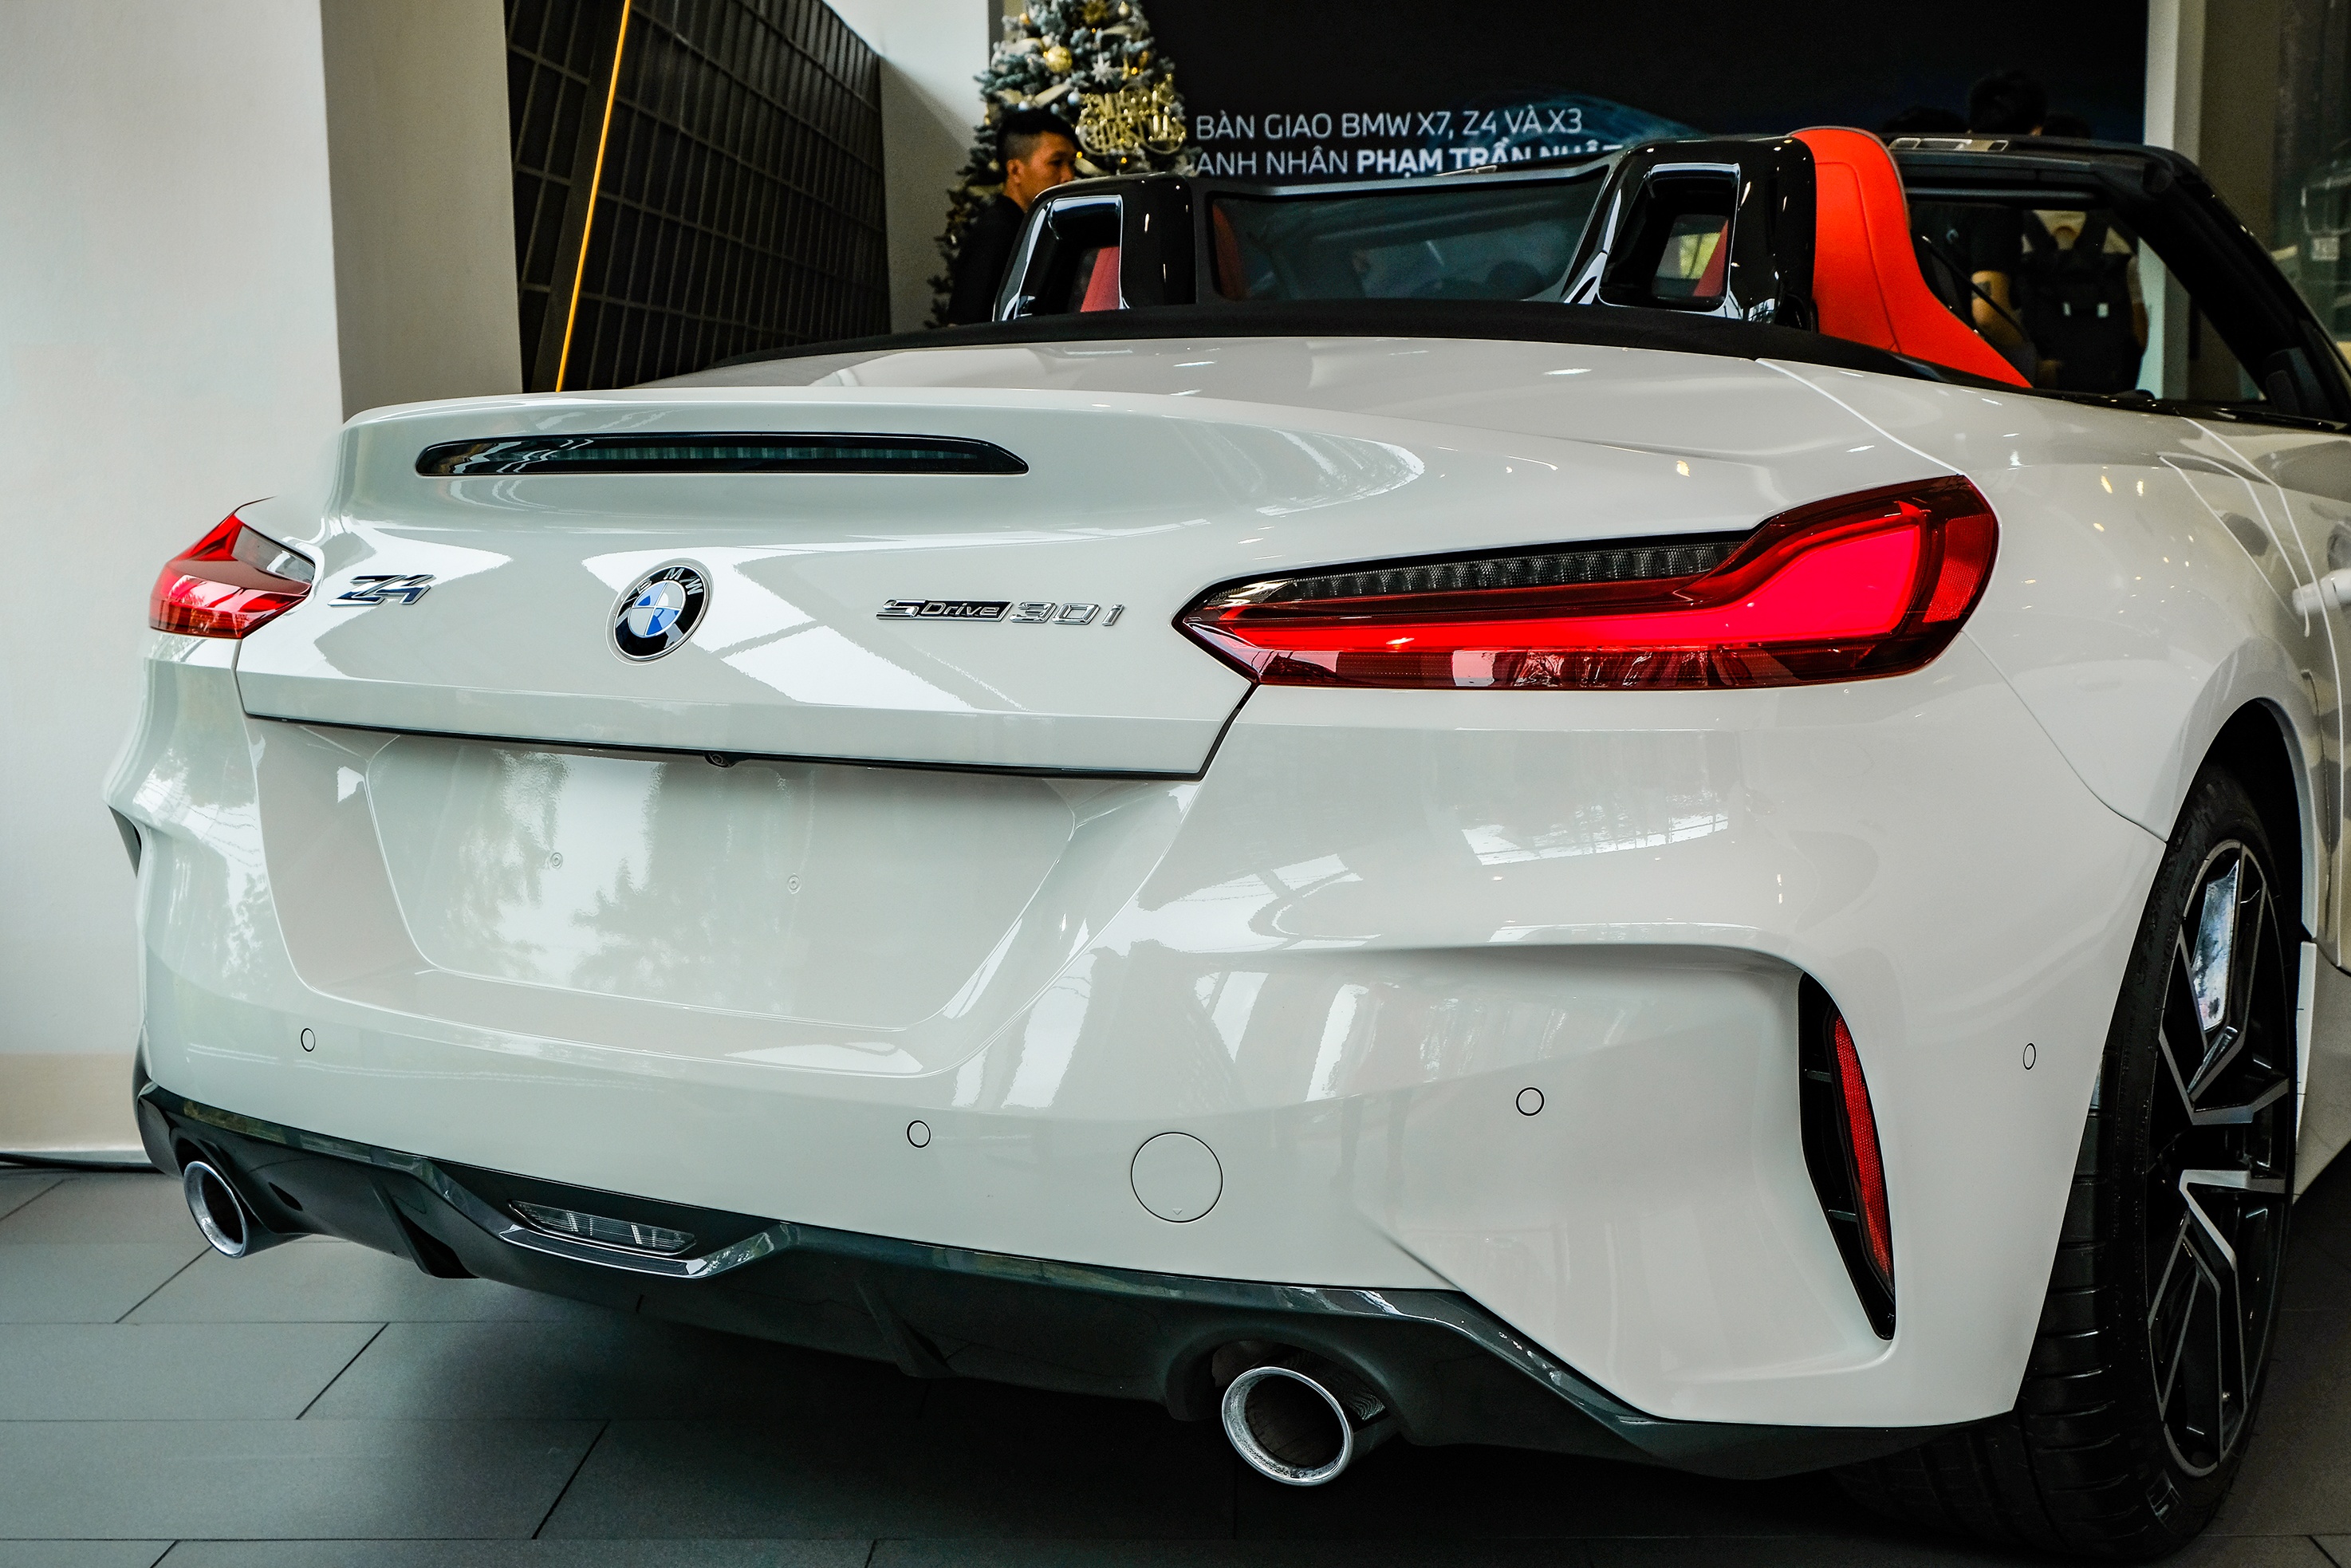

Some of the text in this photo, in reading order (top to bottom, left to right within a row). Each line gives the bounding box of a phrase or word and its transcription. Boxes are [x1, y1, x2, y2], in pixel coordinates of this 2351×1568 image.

[1196, 104, 1582, 140] BÀN GIAO BMW X7, Z4 VÀ X3
[1266, 145, 1348, 175] NHÂN
[1357, 148, 1443, 178] PHẠM
[327, 573, 436, 606] Z4
[637, 567, 703, 596] BMW
